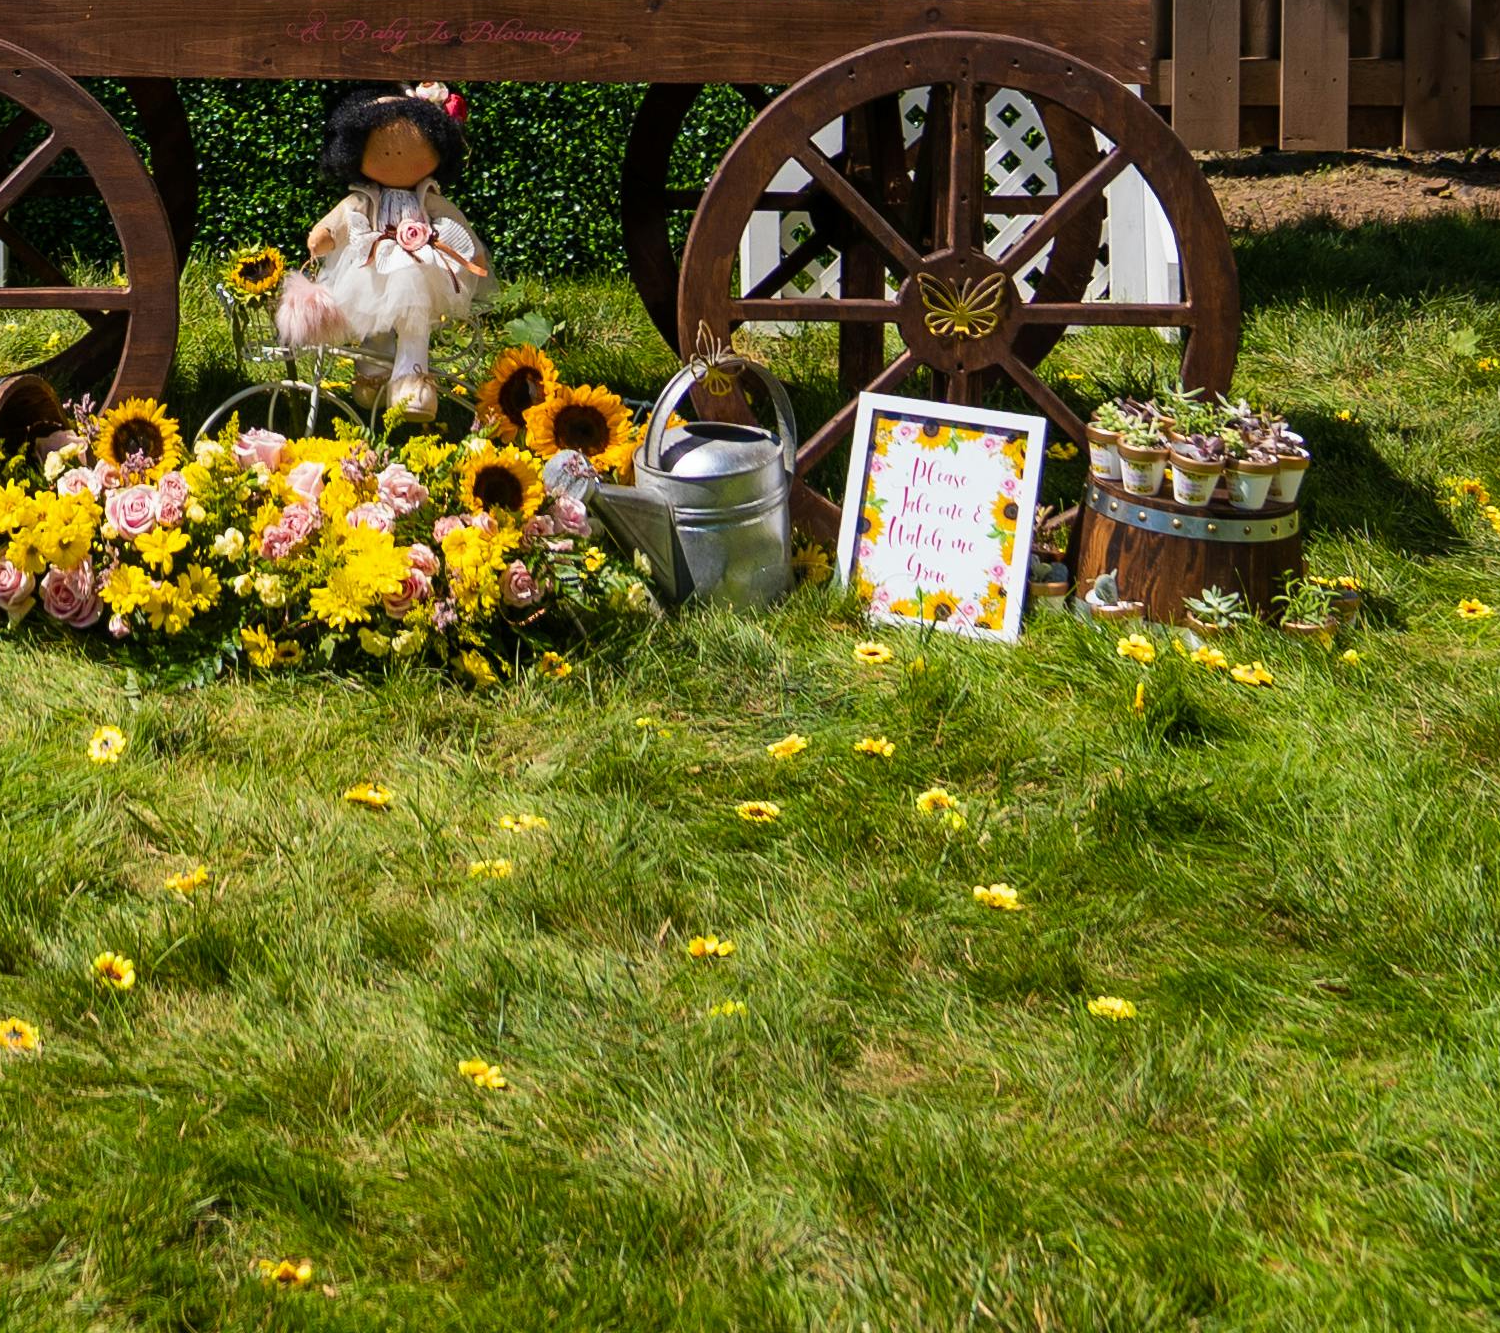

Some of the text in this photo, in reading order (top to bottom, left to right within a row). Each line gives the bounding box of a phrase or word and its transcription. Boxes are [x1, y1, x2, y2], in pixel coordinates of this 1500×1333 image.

[286, 8, 584, 54] A Baby Is Blooming
[912, 457, 968, 489] Please
[901, 486, 984, 524] Take one &
[889, 516, 976, 554] Watch me
[907, 553, 947, 584] Grow
